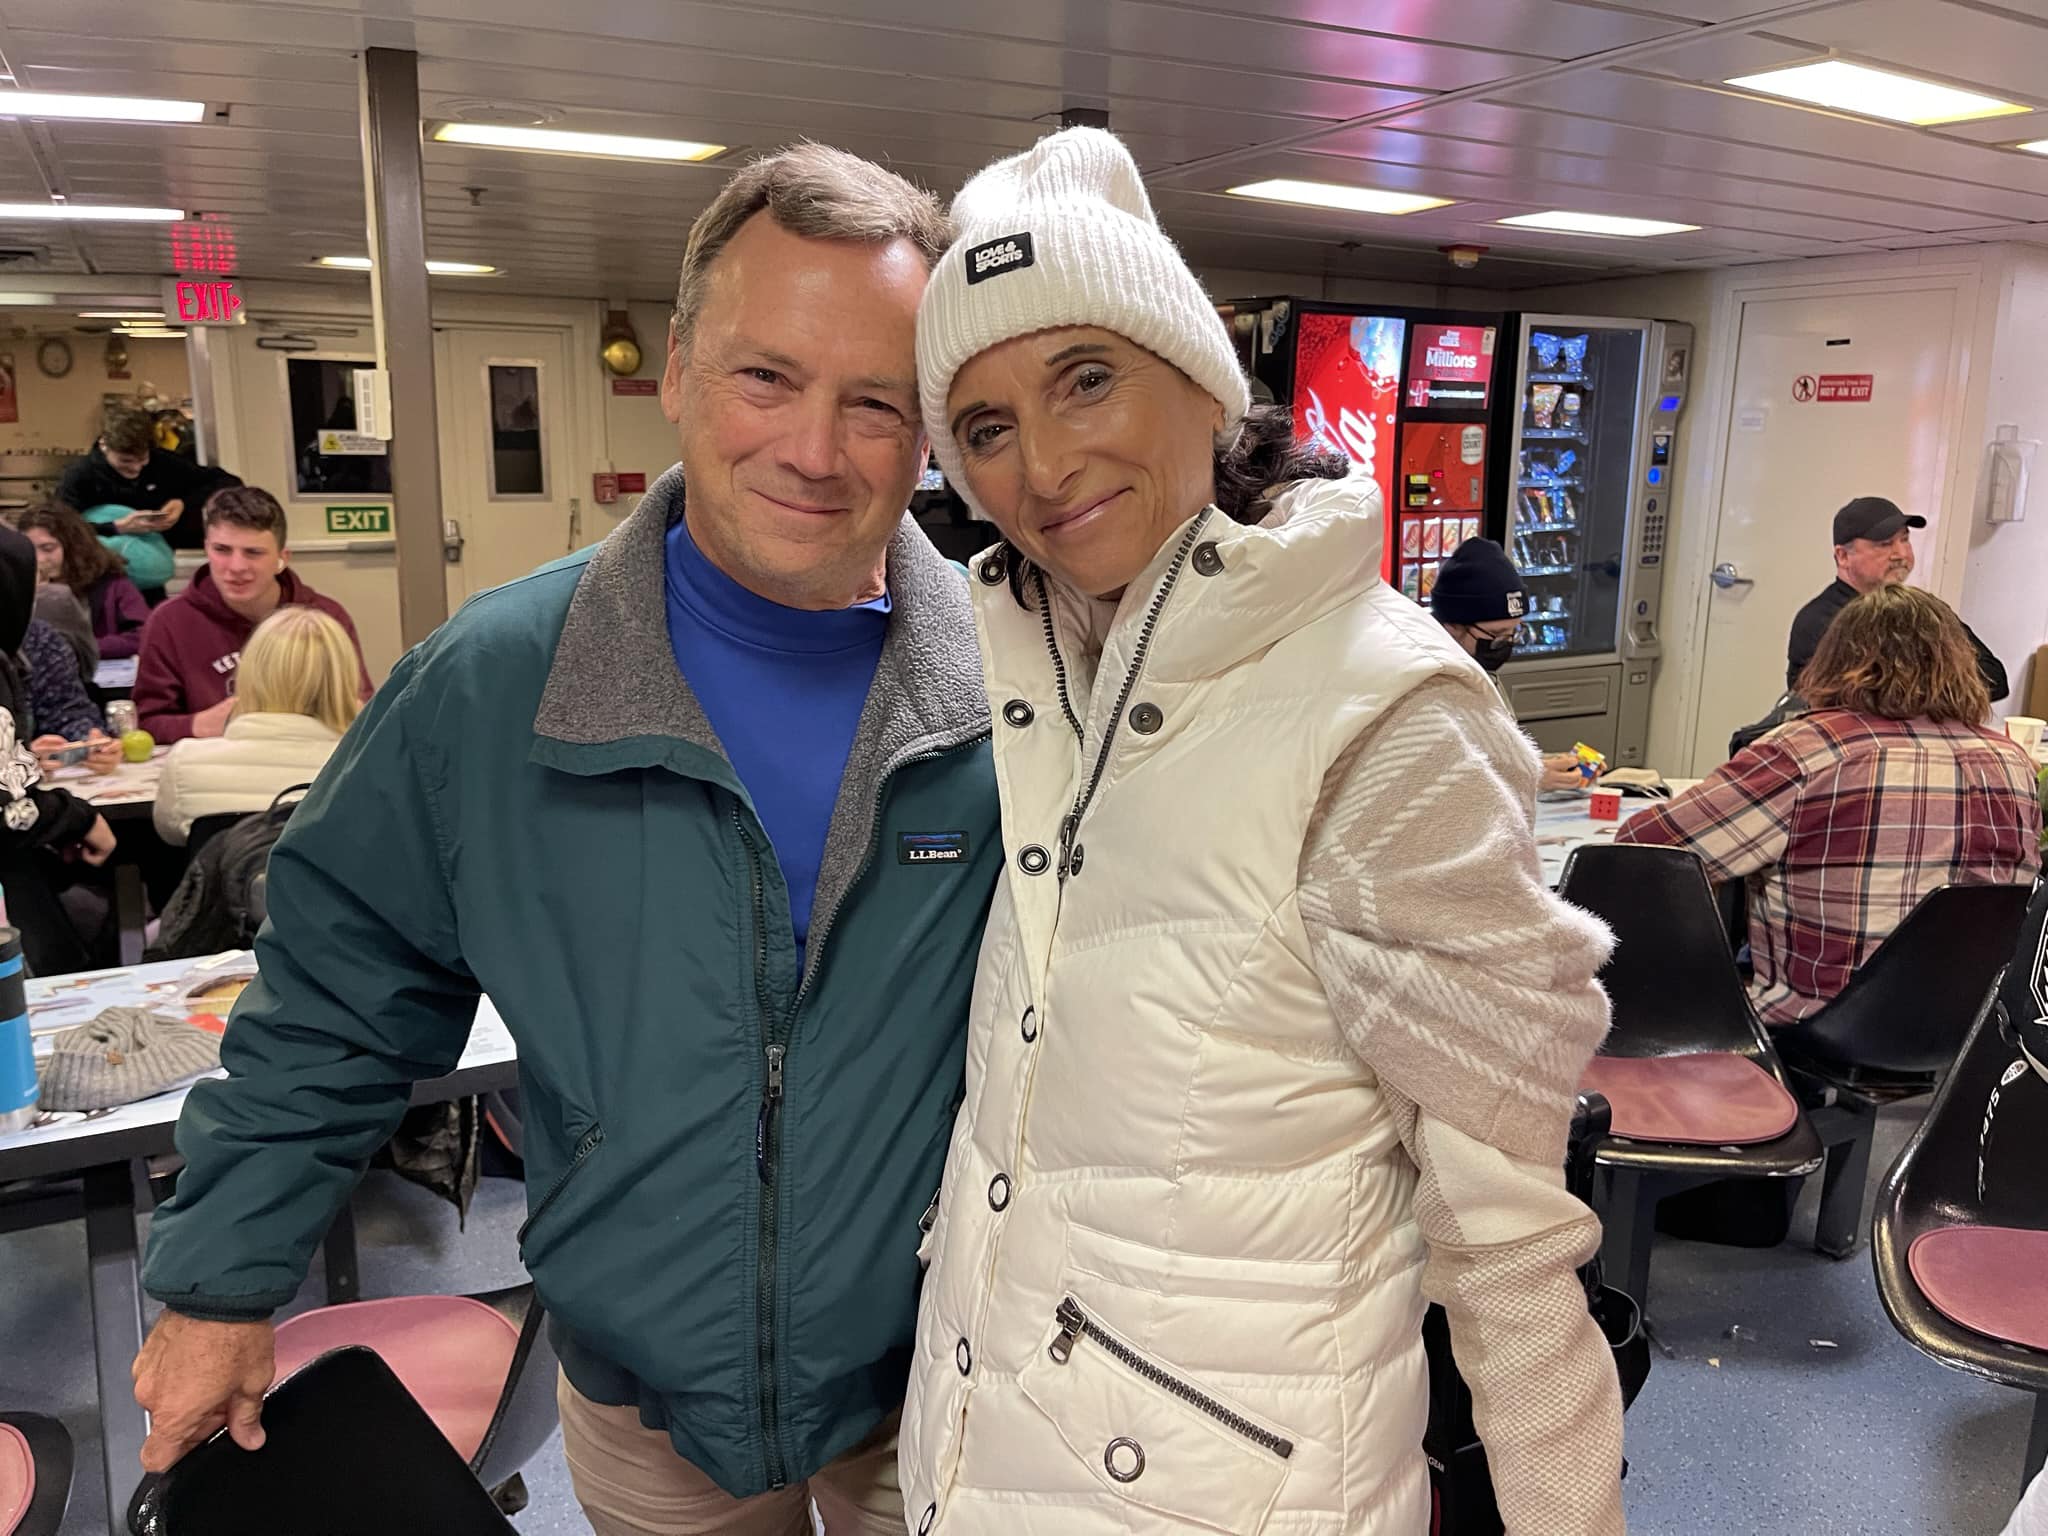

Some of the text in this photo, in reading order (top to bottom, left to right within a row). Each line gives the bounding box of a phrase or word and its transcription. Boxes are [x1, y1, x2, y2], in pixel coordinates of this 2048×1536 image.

[975, 241, 1016, 262] LOVE &
[976, 249, 1023, 272] SPORTS
[176, 282, 233, 321] EXIT
[1425, 349, 1477, 369] Millions
[1819, 387, 1835, 397] NOT
[1851, 387, 1870, 397] EXIT
[331, 510, 385, 530] EXIT
[212, 651, 241, 674] KET
